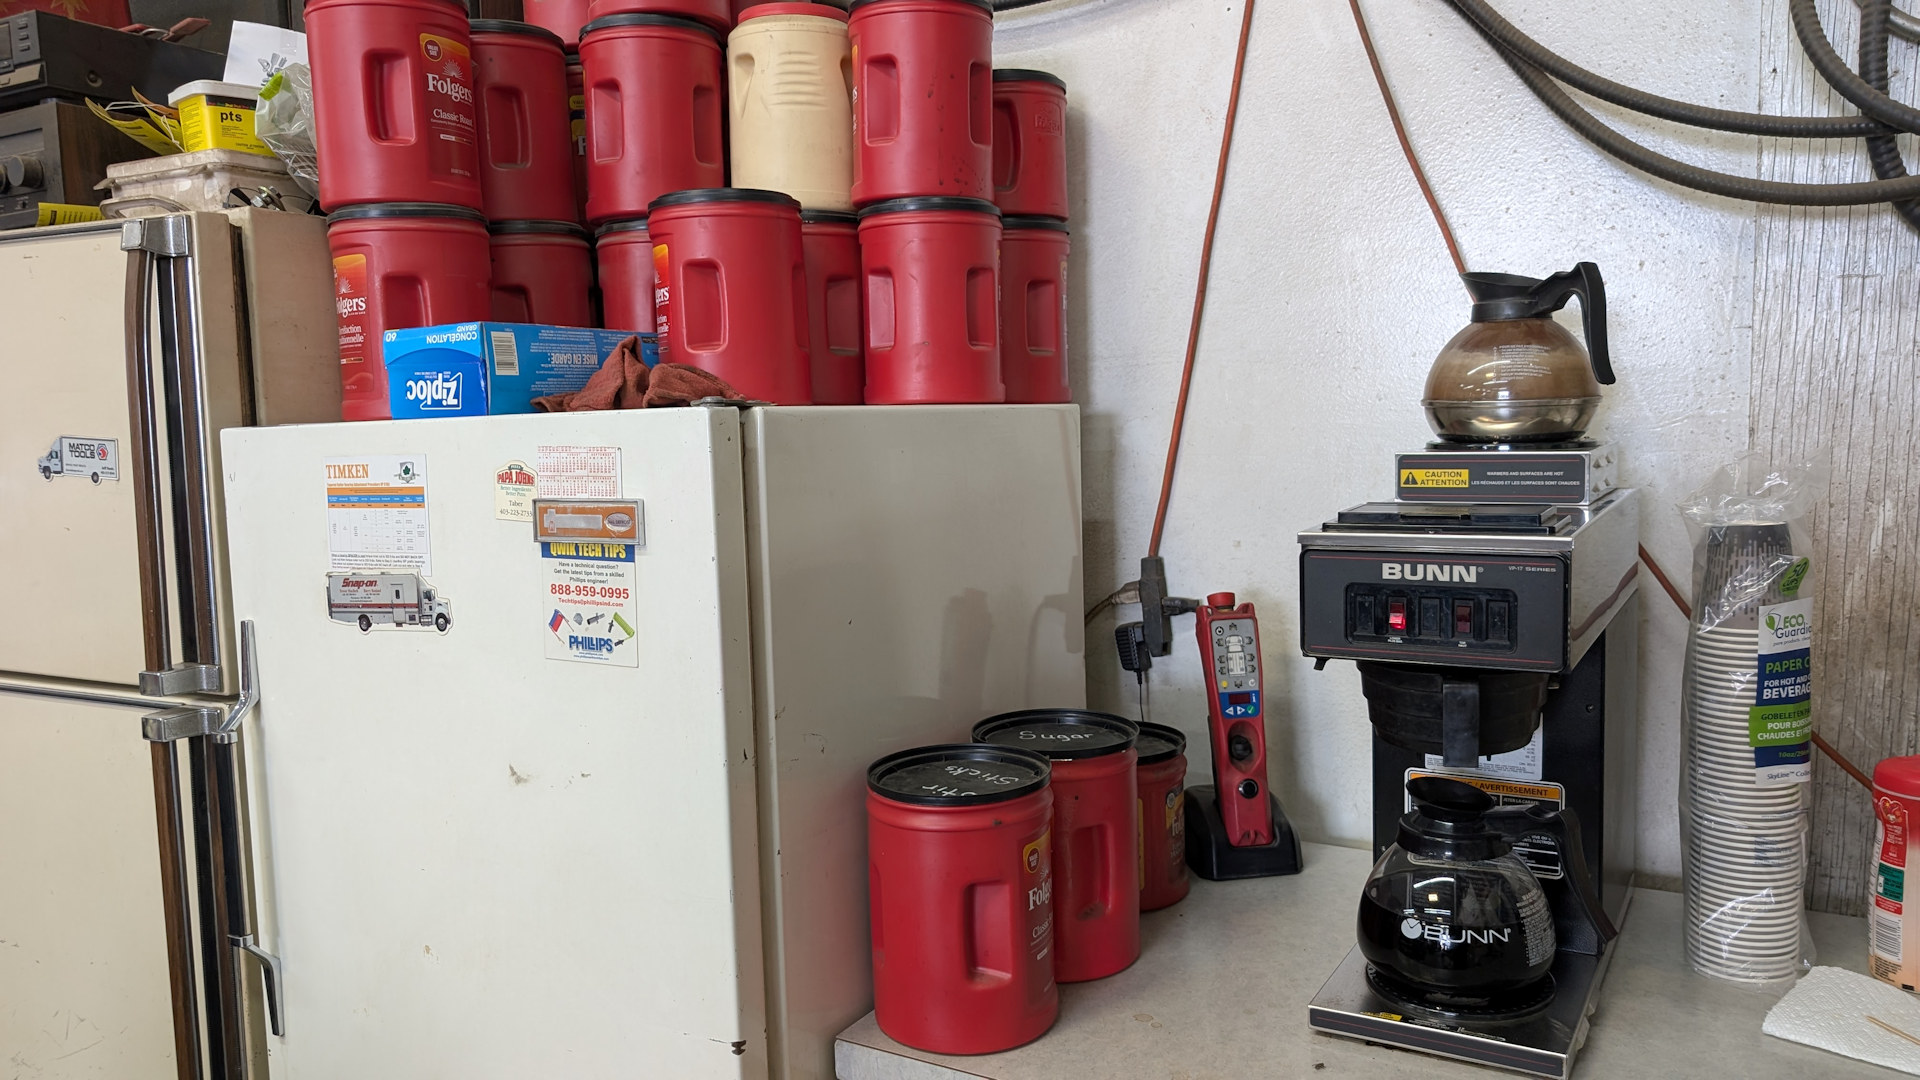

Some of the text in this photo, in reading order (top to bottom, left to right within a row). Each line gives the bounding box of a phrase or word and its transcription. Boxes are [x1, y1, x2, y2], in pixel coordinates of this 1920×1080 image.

[426, 73, 472, 102] Folgers
[220, 111, 242, 123] pts
[433, 108, 459, 122] Classic
[459, 114, 473, 127] Roast
[456, 324, 478, 332] GRAND
[385, 332, 397, 342] 60
[426, 331, 478, 344] CONGÉLATION
[550, 353, 573, 364] GARDE
[572, 353, 582, 365] EN
[582, 353, 598, 365] MISE
[406, 373, 458, 406] Ziploc
[69, 442, 95, 452] MATCO
[69, 450, 96, 459] TOOLS
[326, 464, 369, 479] TIMKEN
[497, 470, 514, 484] PAPA
[1420, 478, 1468, 486] ATTENTION
[549, 542, 627, 559] QWIK TECH TIPS
[1381, 562, 1477, 583] BUNN
[1793, 561, 1808, 577] 50
[341, 577, 378, 589] Snap-on
[550, 583, 630, 600] 888-959-0995
[558, 597, 624, 608] Techtips@phillipsind.com
[1783, 613, 1805, 629] ECO
[568, 635, 614, 653] PHILLIPS
[1765, 658, 1803, 675] PAPER
[1764, 674, 1808, 688] FOR HOT AND
[1762, 682, 1811, 700] BEVERAG
[1761, 711, 1798, 721] GOBELET
[1767, 721, 1791, 730] POUR
[1018, 729, 1094, 742] Sugar
[1757, 731, 1795, 740] CHAUDES
[1795, 729, 1803, 737] ET
[944, 765, 1019, 785] Sticks
[1479, 783, 1548, 797] AVERTISSEMENT
[1028, 878, 1052, 911] Folg
[1424, 925, 1508, 944] BUNN
